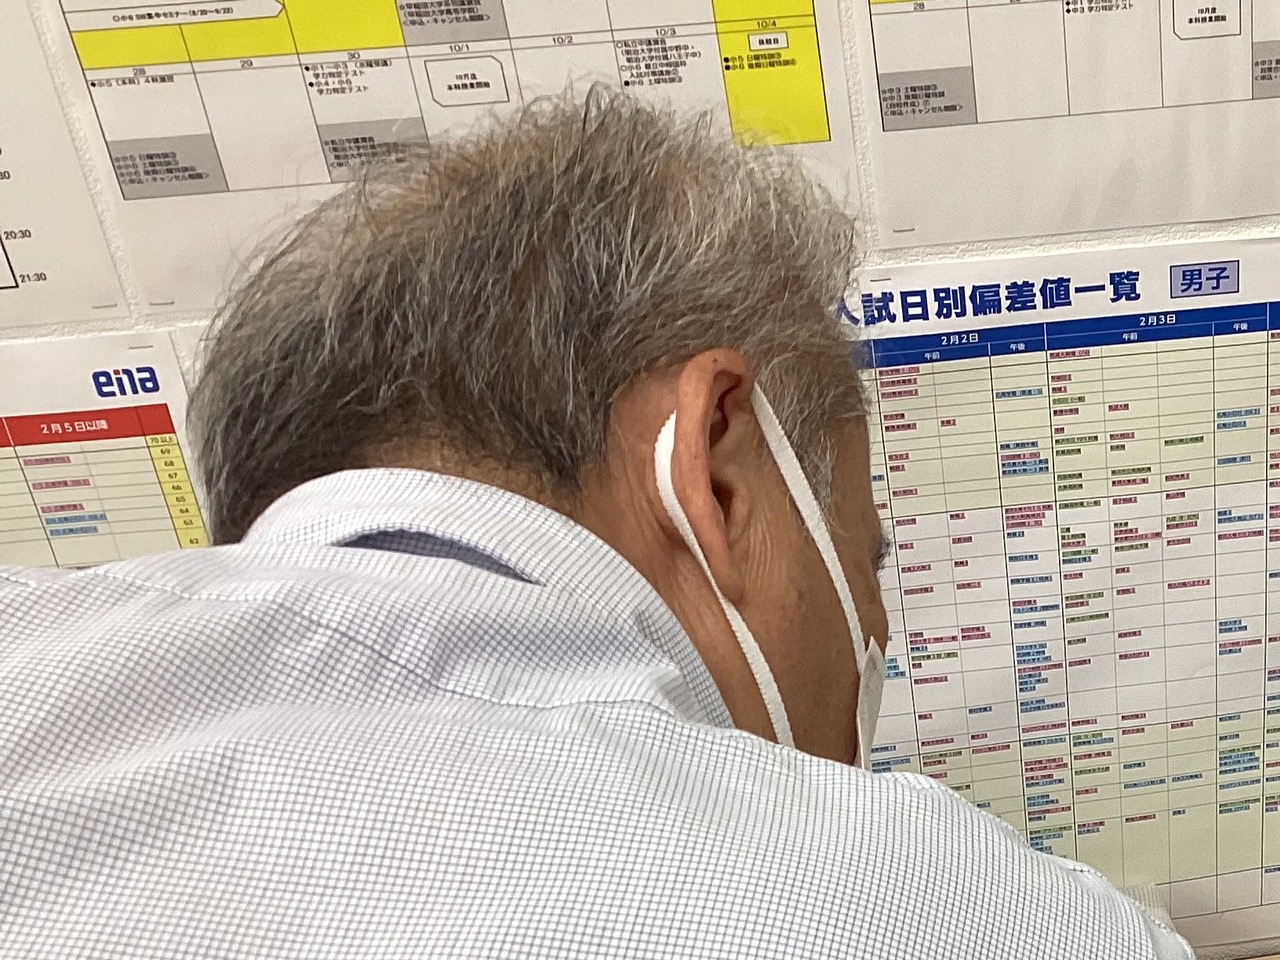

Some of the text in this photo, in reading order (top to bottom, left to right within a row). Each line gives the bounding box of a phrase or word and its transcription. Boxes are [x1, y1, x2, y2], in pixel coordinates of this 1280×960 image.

[913, 3, 925, 11] 28
[756, 20, 777, 28] 10/4
[552, 36, 573, 44] 10/2
[449, 44, 470, 52] 10/1
[240, 60, 253, 68] 29
[132, 68, 146, 76] 28
[4, 229, 31, 240] 20:30
[20, 273, 47, 283] 21:30
[1180, 266, 1231, 293] 男子
[1139, 314, 1176, 326] 2月3日
[941, 333, 979, 345] 2月2日
[1122, 332, 1138, 341] 午前
[924, 352, 940, 360] 午前
[92, 366, 160, 397] ena
[40, 418, 109, 434] 2月5日以降
